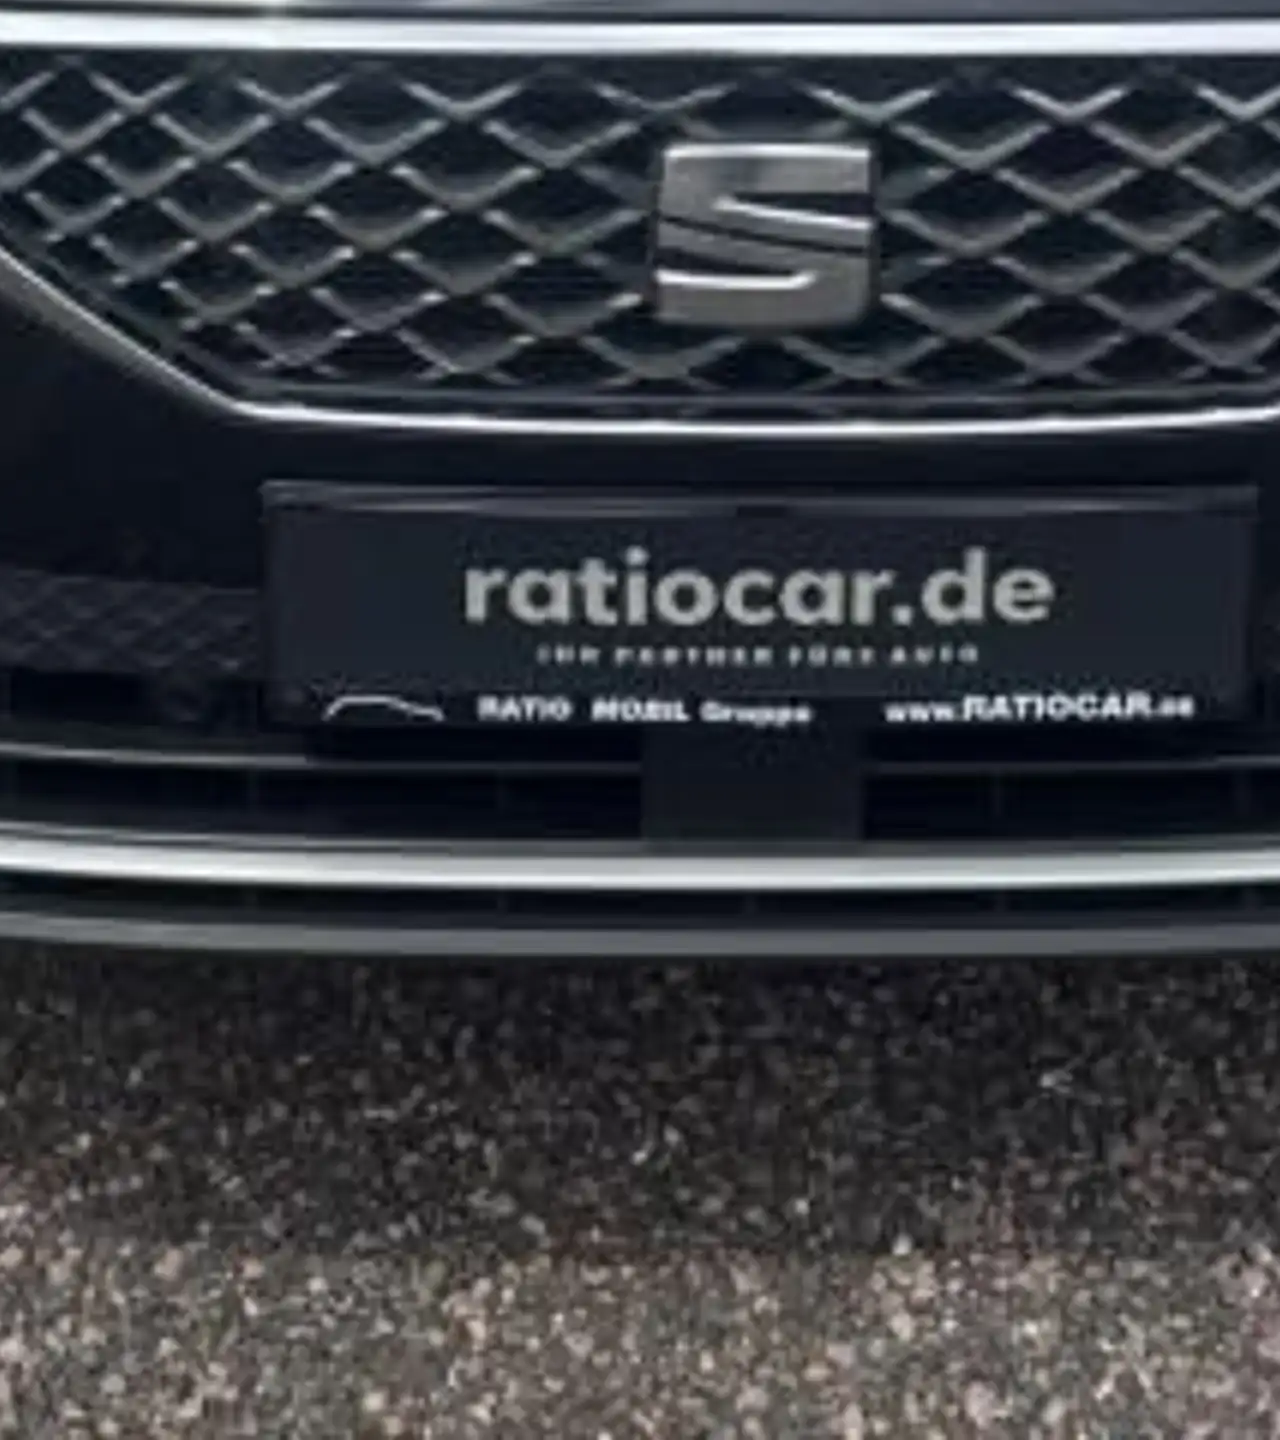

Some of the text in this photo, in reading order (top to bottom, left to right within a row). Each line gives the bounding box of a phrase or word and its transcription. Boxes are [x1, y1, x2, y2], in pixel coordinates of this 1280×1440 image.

[465, 545, 1054, 626] ratiocar.de
[476, 694, 573, 722] RATIO
[589, 696, 691, 722] MOBIL
[699, 699, 813, 728] Gruppe
